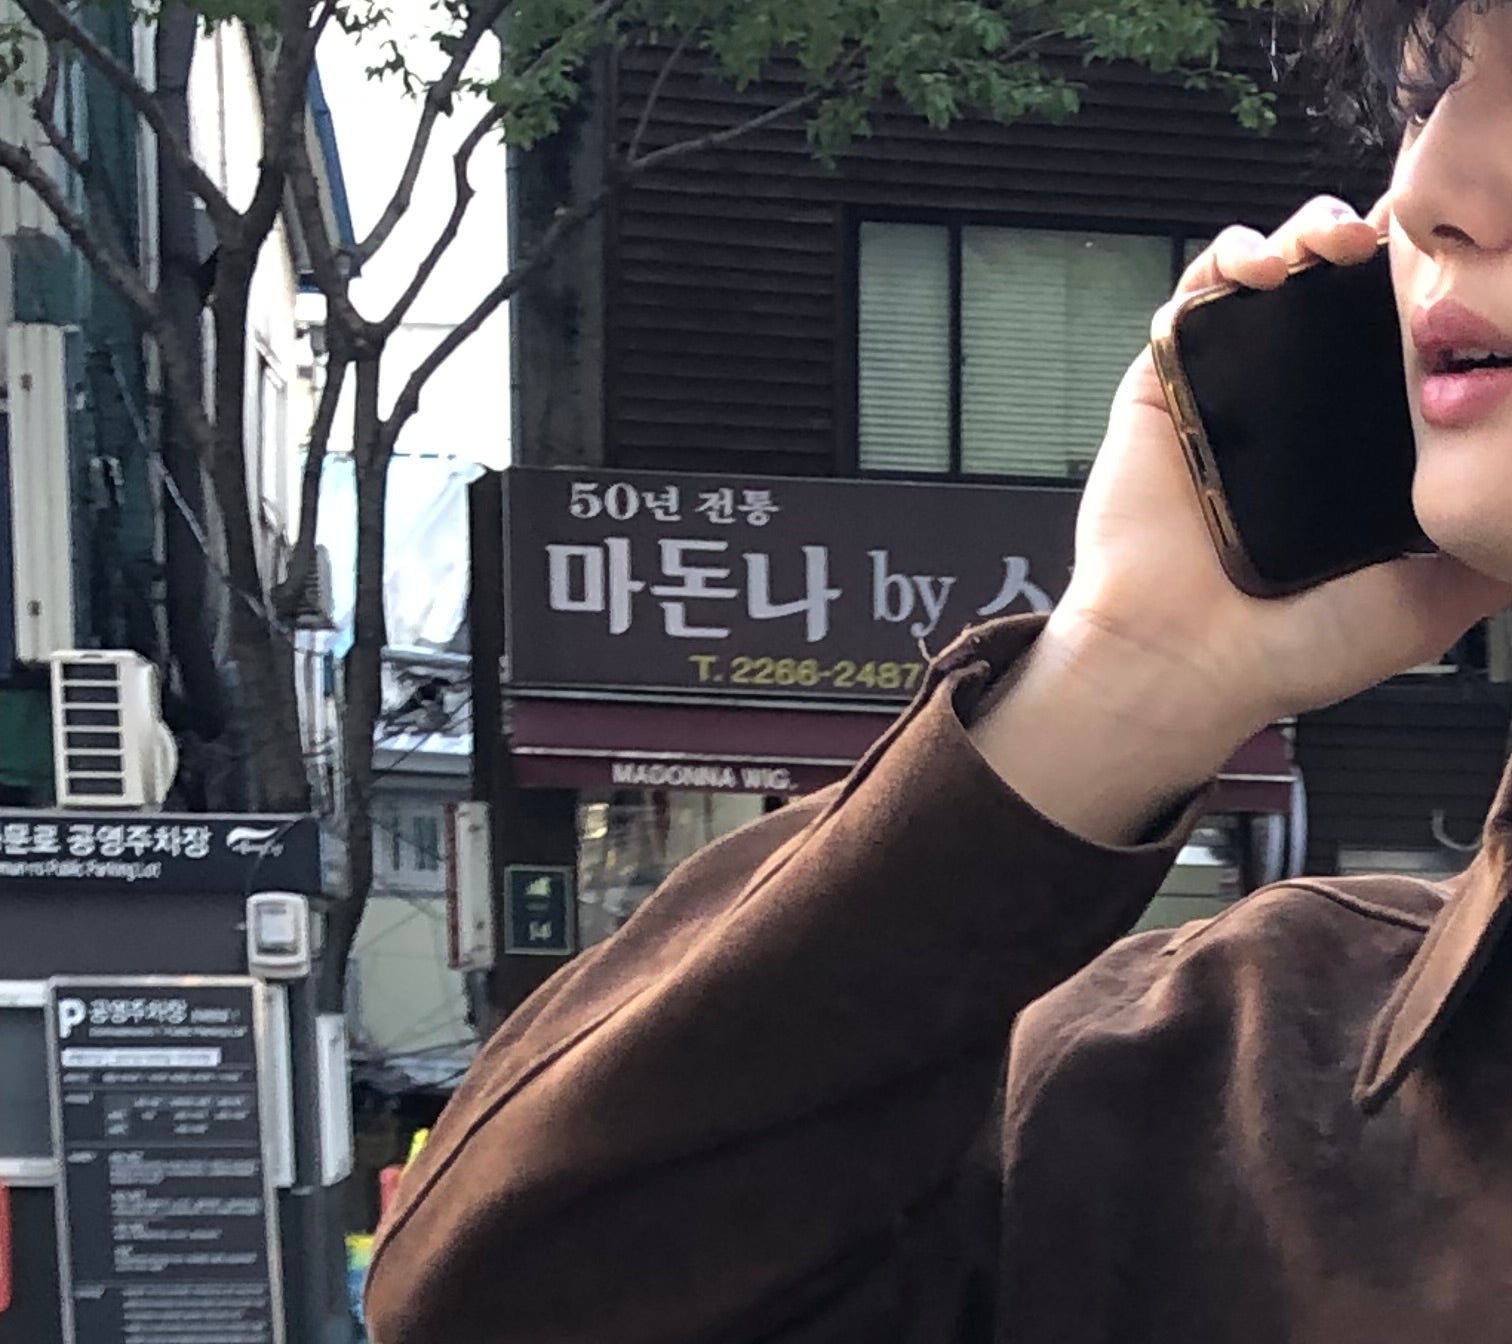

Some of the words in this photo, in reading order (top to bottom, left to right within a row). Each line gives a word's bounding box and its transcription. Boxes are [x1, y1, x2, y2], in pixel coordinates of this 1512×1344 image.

[569, 482, 682, 522] 50년
[695, 488, 780, 526] 전통
[545, 537, 843, 642] 마돈나
[866, 549, 958, 639] by
[612, 763, 736, 787] MADONNA
[0, 823, 61, 855] 문로
[66, 823, 213, 858] 공영주차장
